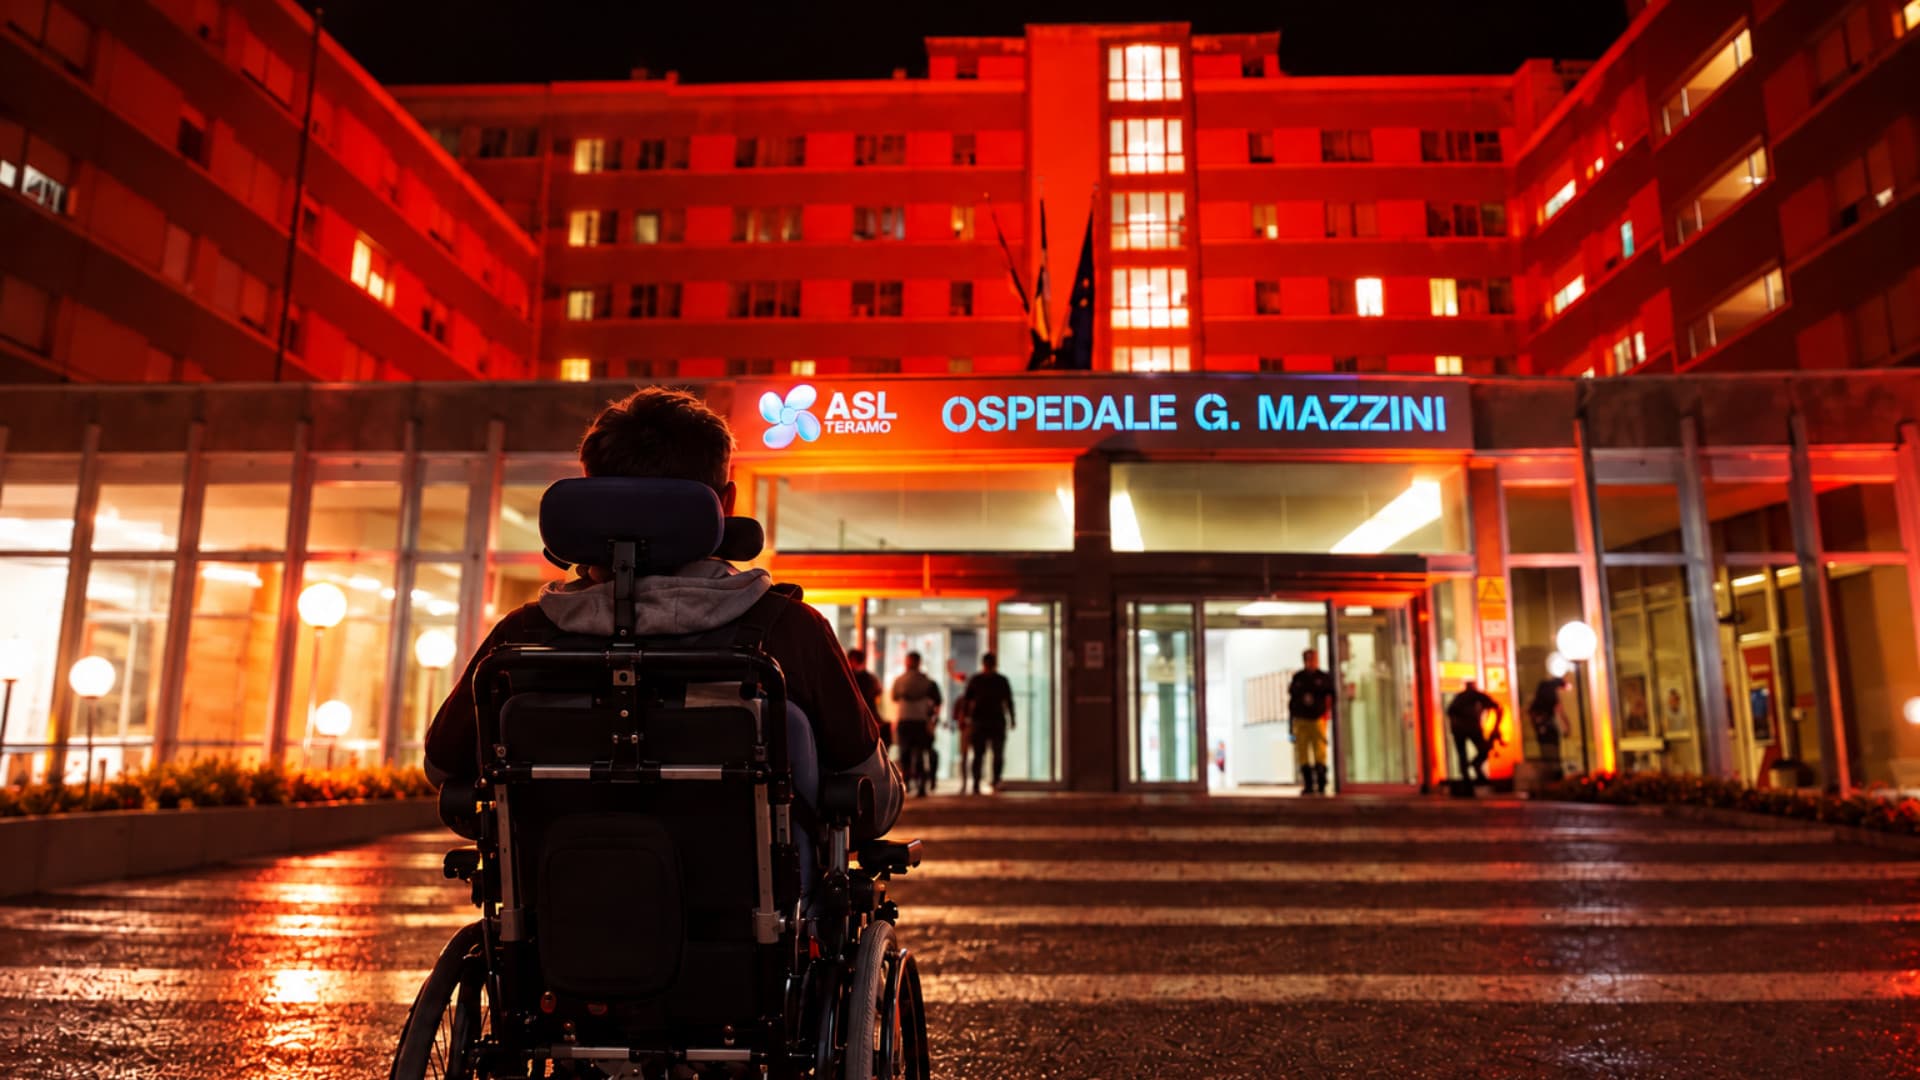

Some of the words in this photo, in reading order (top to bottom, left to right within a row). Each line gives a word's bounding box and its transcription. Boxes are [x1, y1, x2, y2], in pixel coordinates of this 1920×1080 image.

[825, 391, 897, 420] ASL
[942, 394, 1177, 432] OSPEDALE
[1195, 393, 1240, 431] G.
[1258, 394, 1446, 432] MAZZINI
[824, 420, 891, 434] TERAMO
